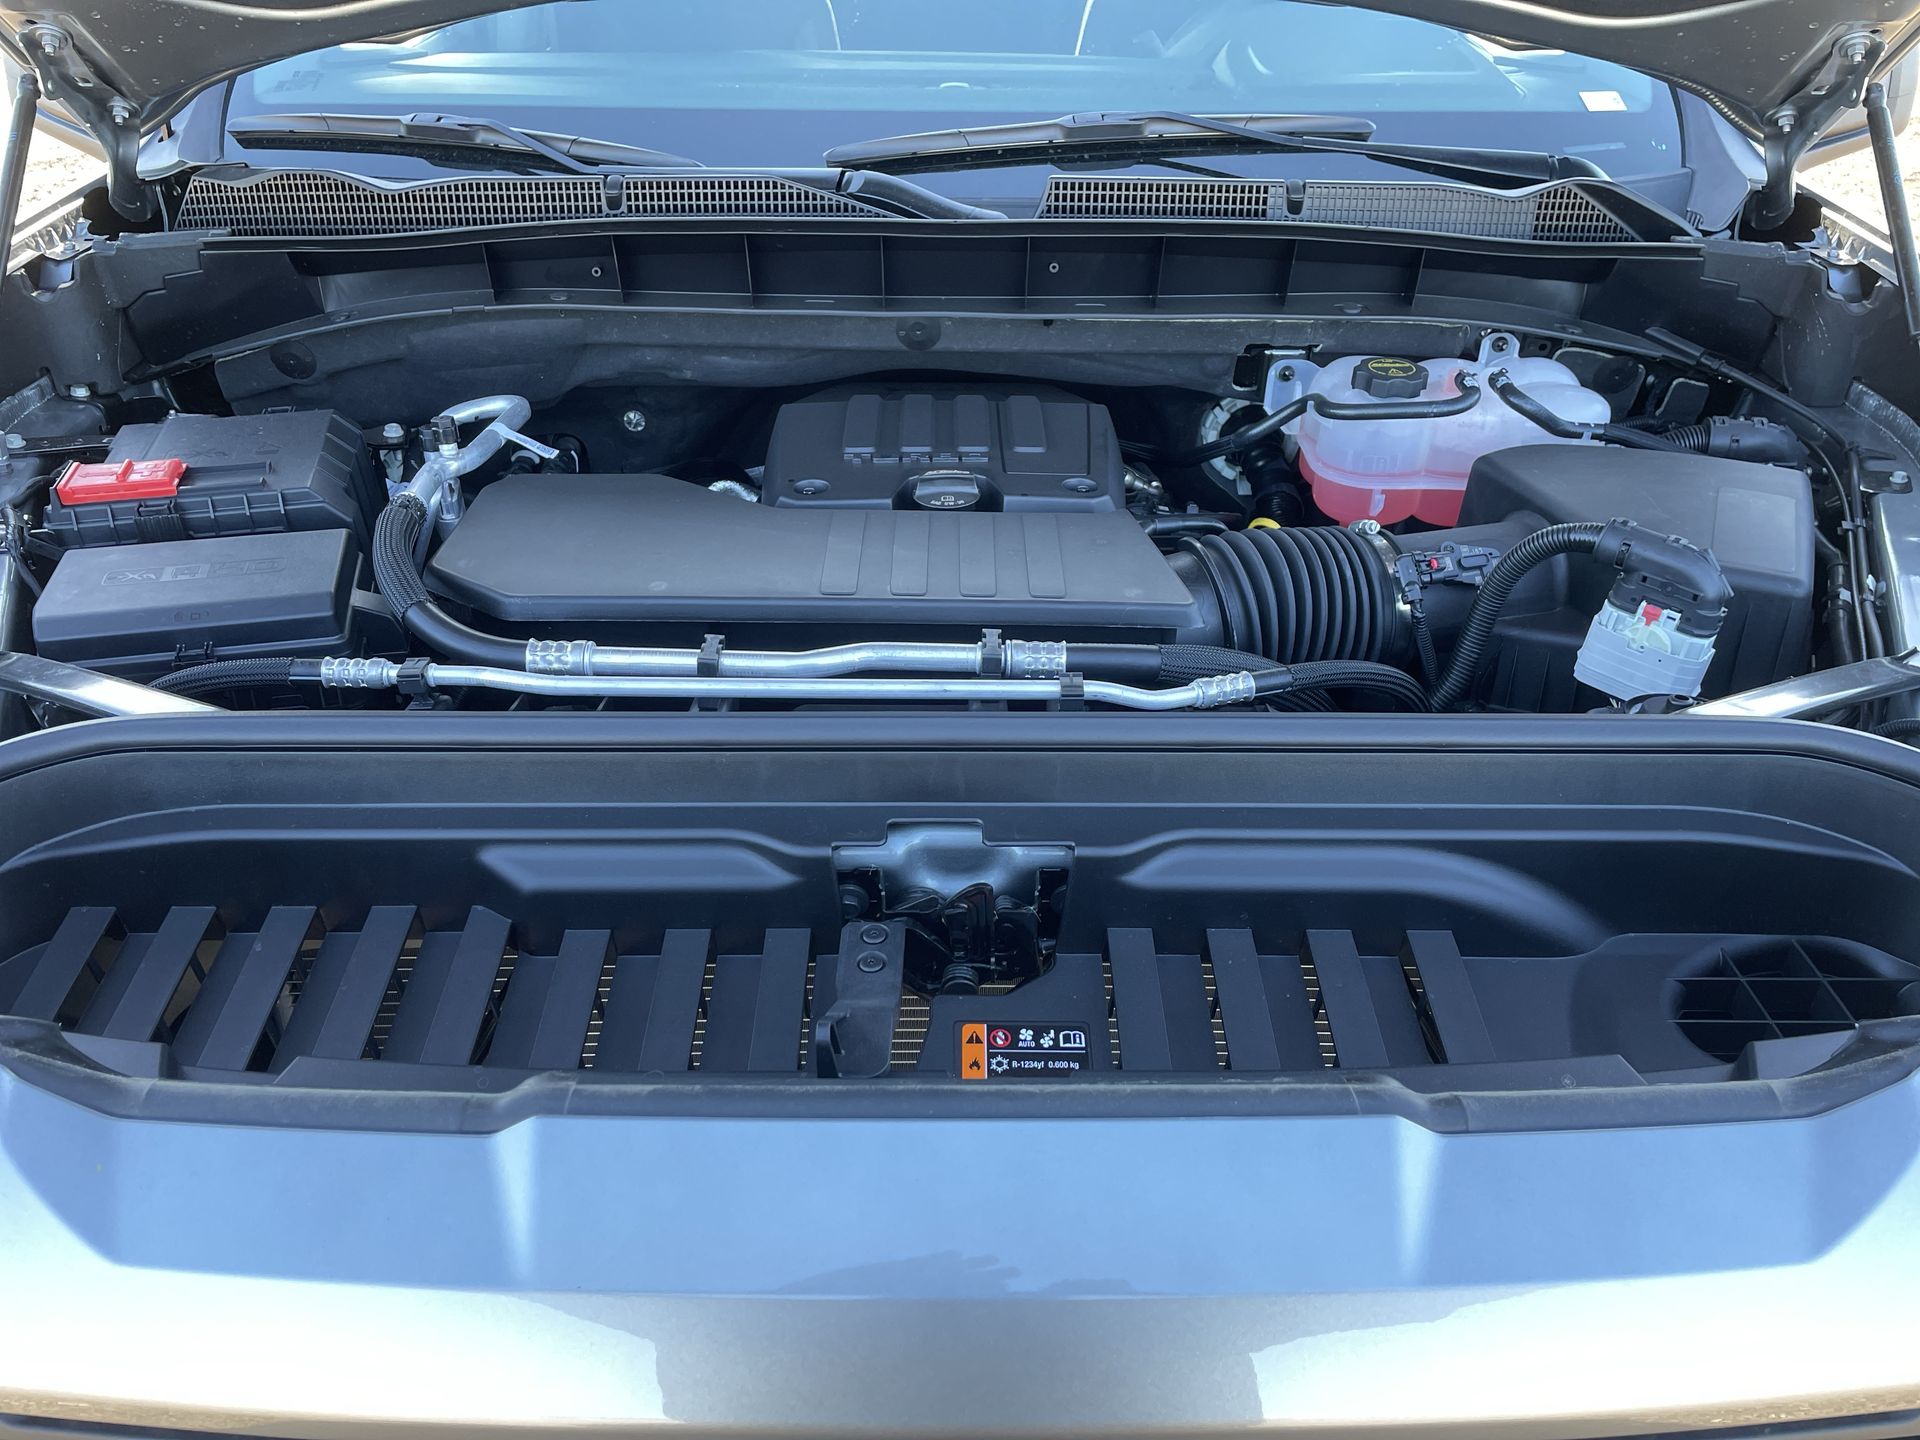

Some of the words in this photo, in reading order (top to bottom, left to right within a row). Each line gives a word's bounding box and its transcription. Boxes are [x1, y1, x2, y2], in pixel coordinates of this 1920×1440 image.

[1018, 1040, 1036, 1048] AUTO
[1012, 1060, 1045, 1070] R-1234yf
[1048, 1060, 1068, 1069] 0.600
[1069, 1060, 1080, 1070] kg
